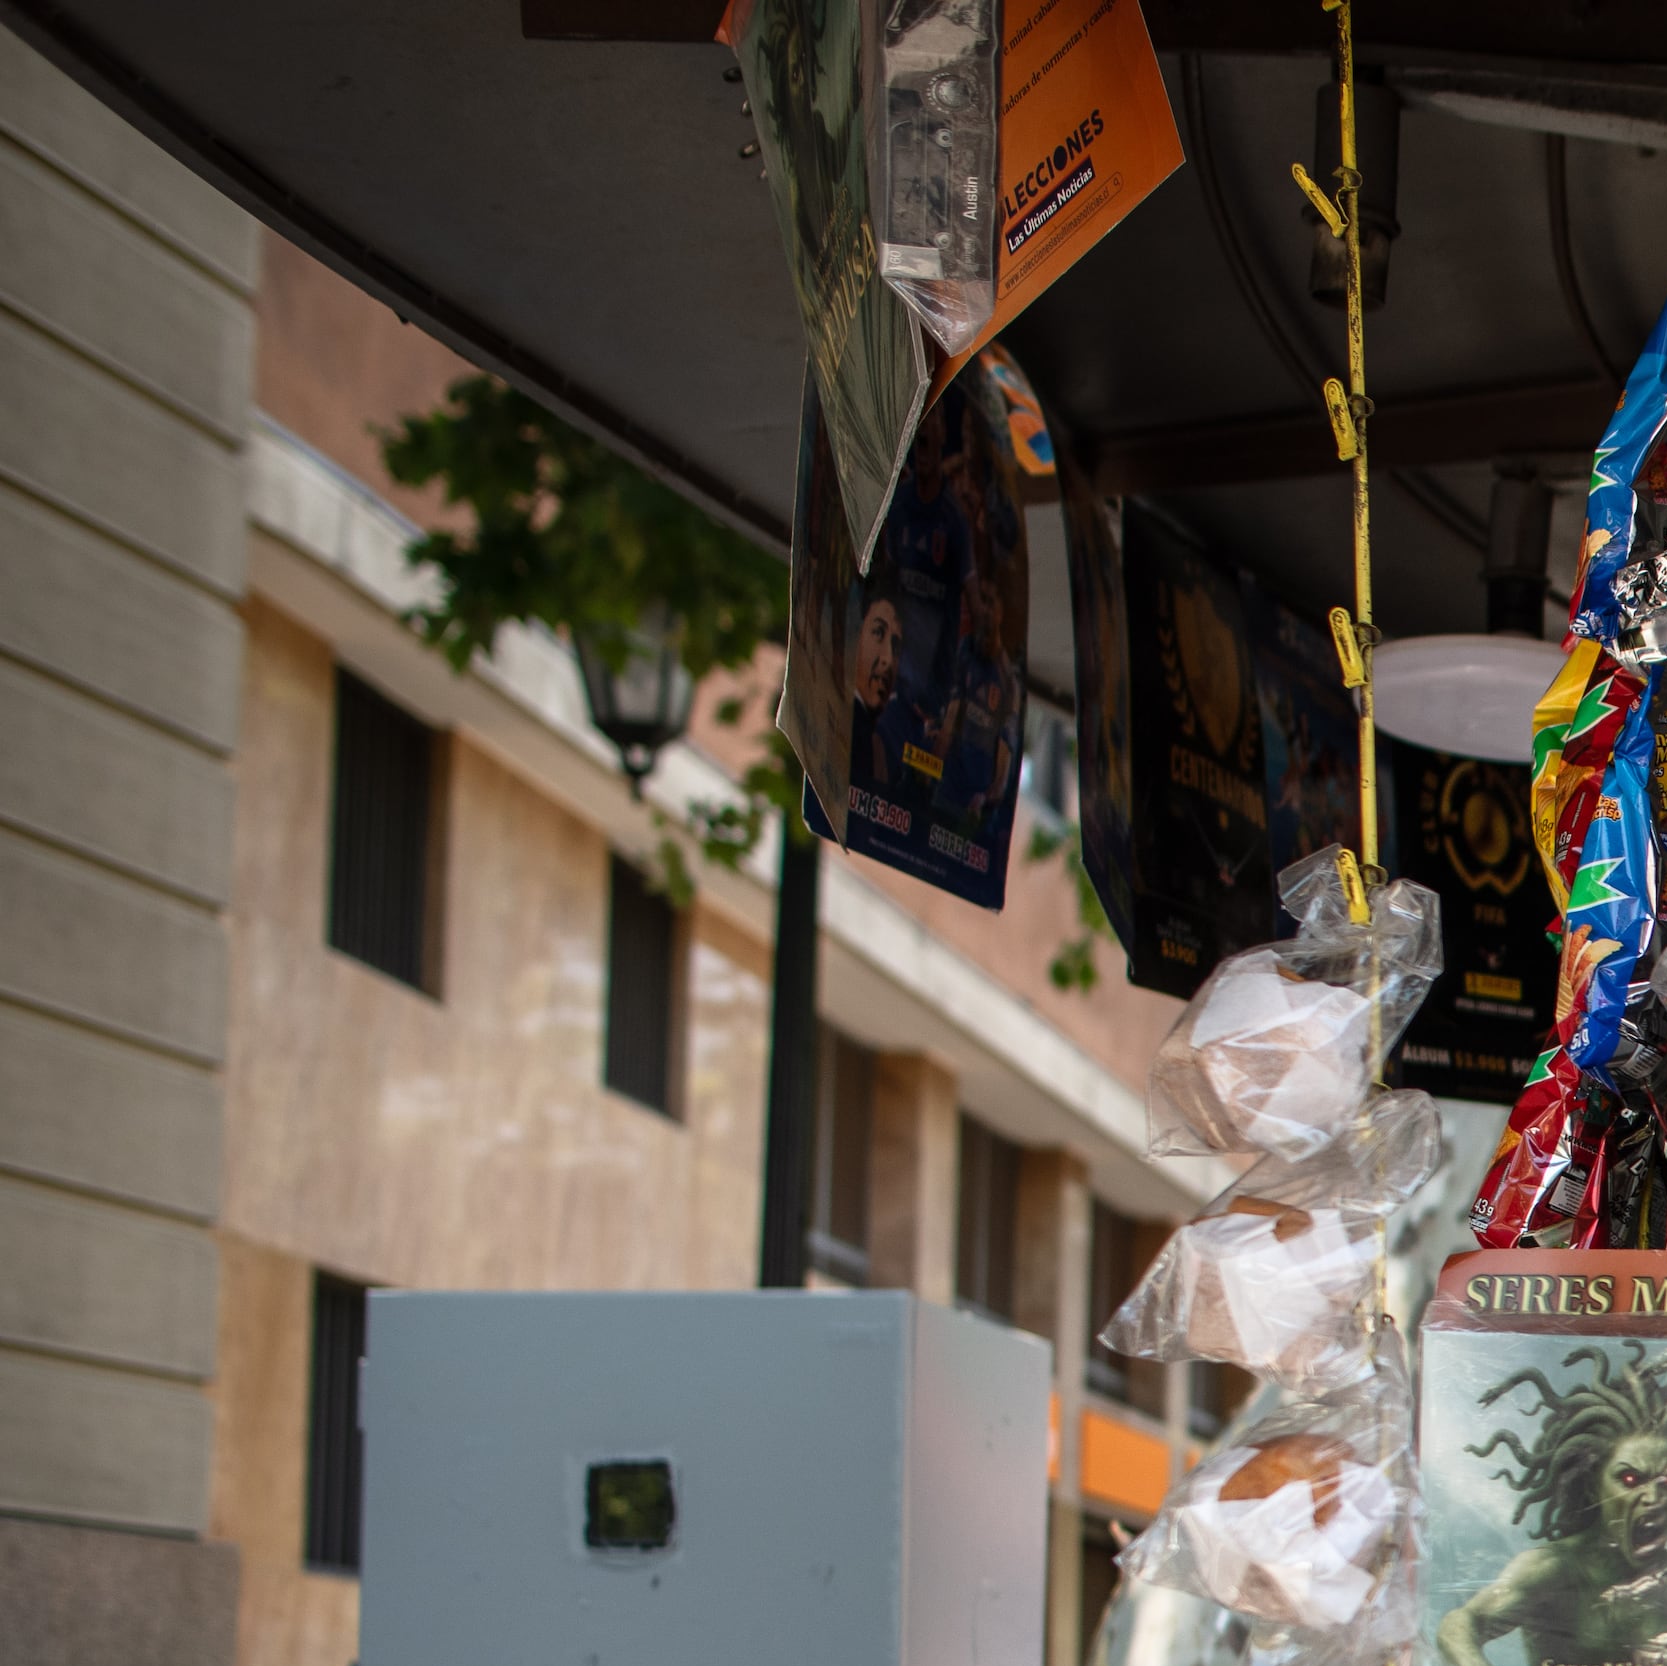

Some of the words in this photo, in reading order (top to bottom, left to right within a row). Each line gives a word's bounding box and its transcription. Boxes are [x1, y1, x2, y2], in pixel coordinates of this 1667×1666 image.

[962, 176, 979, 221] Austin
[1008, 231, 1025, 252] Las
[1023, 199, 1057, 237] Últimas
[1057, 166, 1093, 206] Noticias
[1465, 1273, 1614, 1316] SERES
